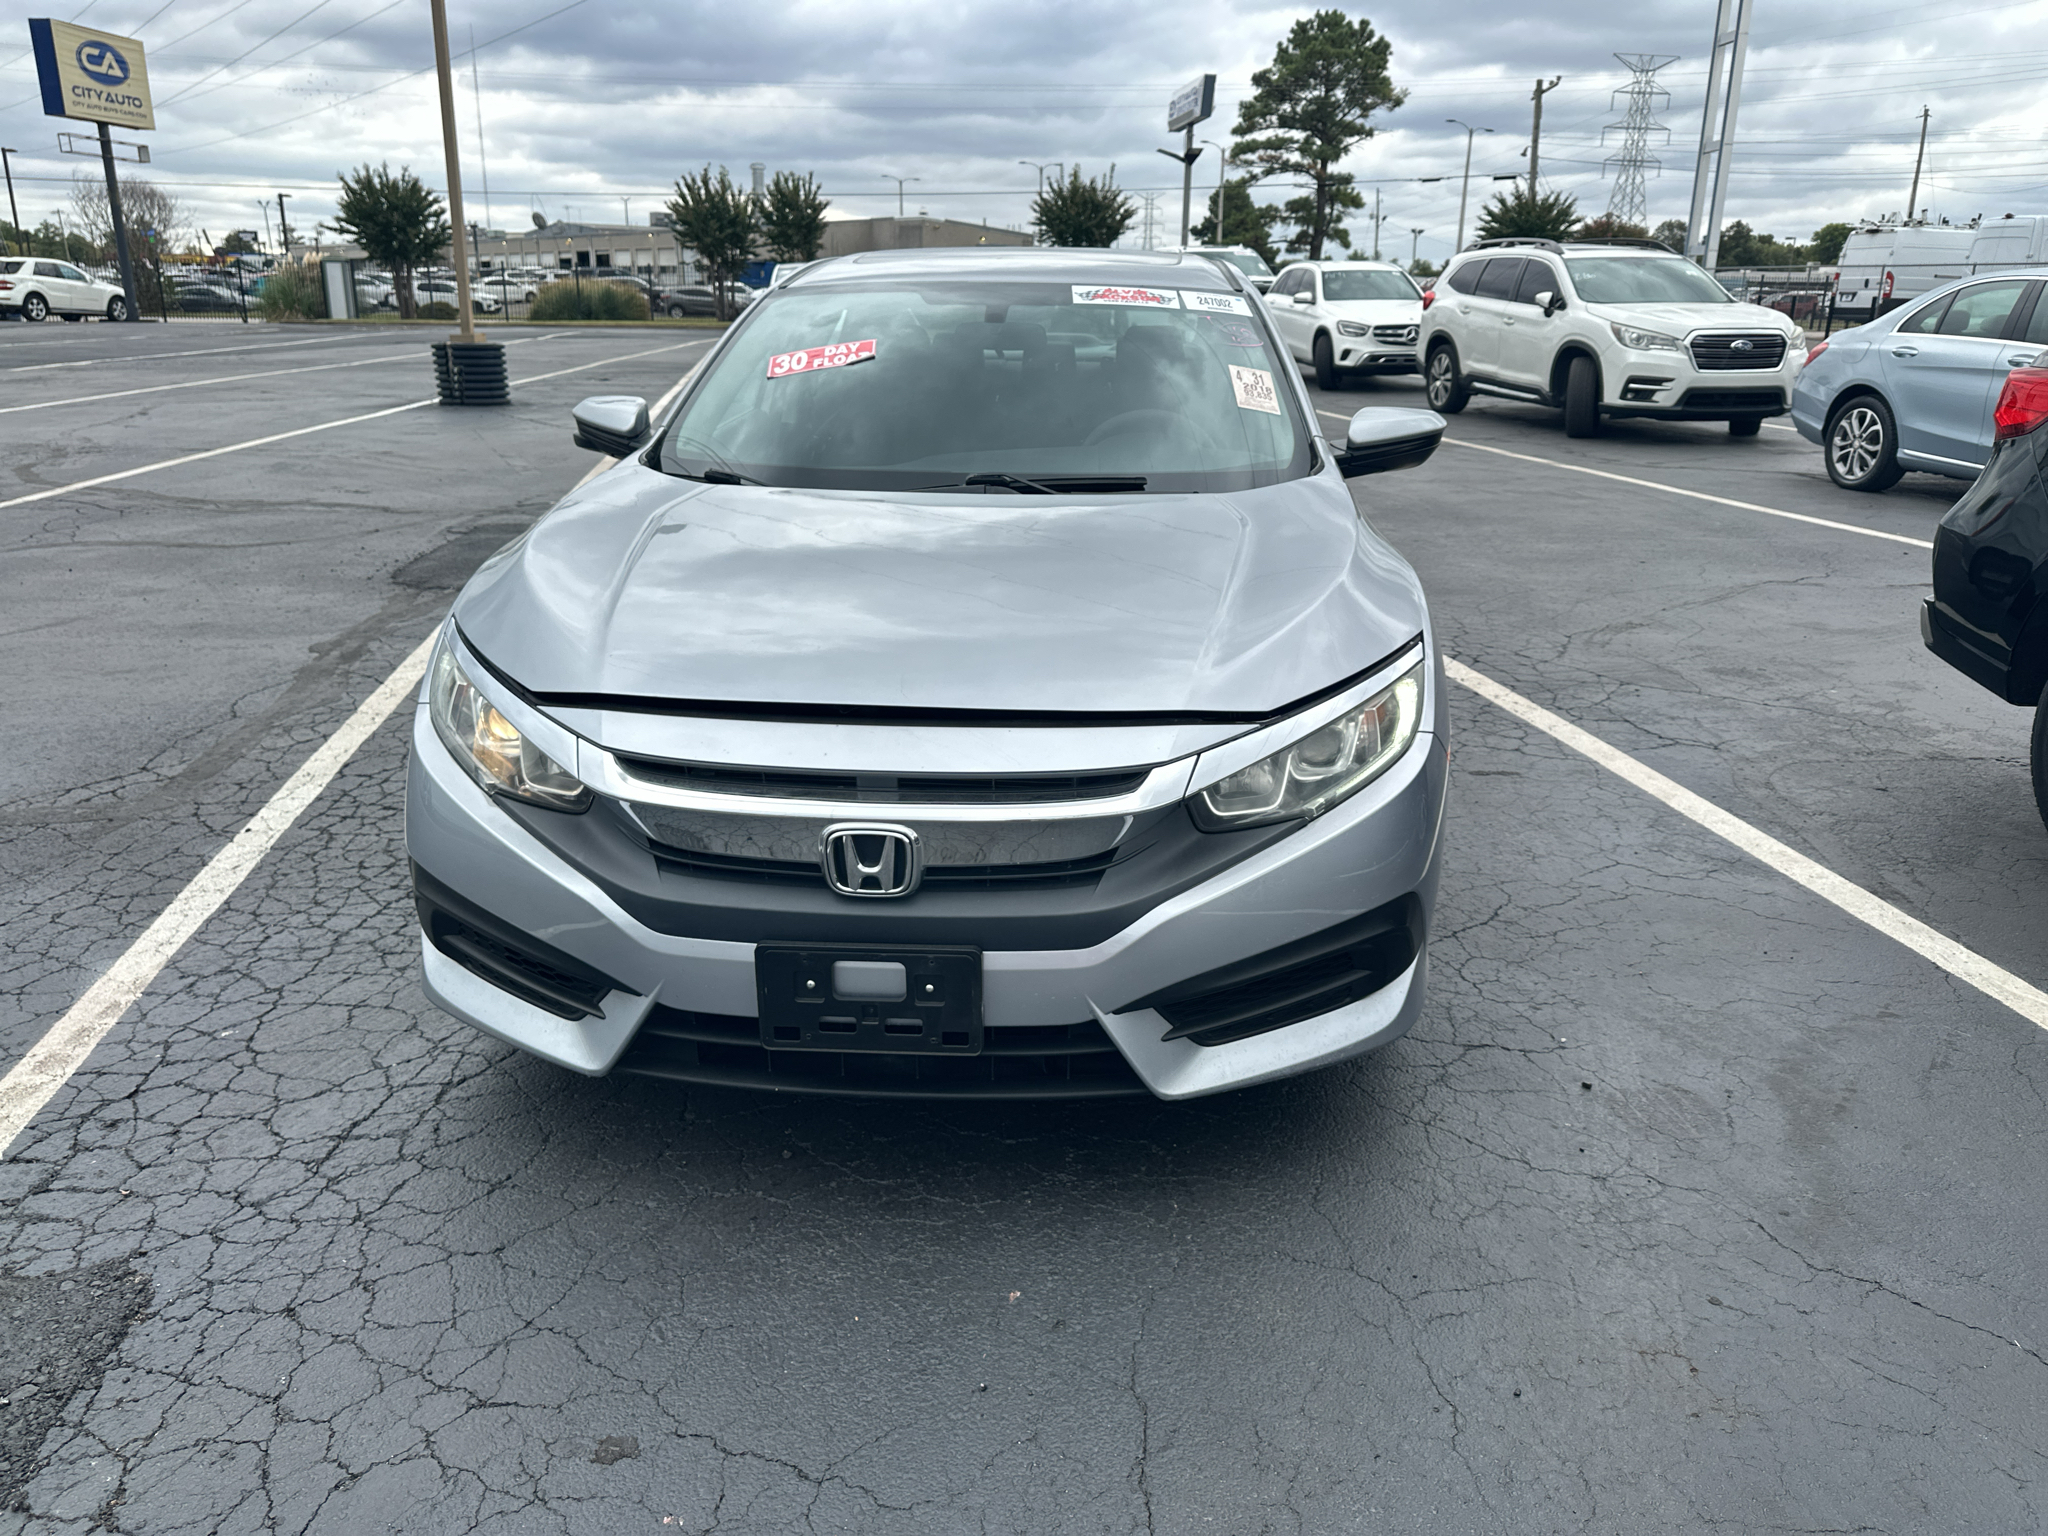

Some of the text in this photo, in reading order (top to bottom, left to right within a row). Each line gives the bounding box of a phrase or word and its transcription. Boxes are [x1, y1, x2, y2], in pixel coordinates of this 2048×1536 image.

[80, 46, 125, 78] CA
[72, 85, 143, 108] CITY AUTO
[72, 100, 85, 108] CITY
[103, 106, 119, 114] BUYS
[1091, 292, 1161, 303] JACKSON
[1196, 296, 1233, 308] 247002
[824, 343, 860, 356] DAY
[773, 351, 808, 374] 30
[1236, 370, 1265, 386] 4 31
[1242, 382, 1272, 394] 2018
